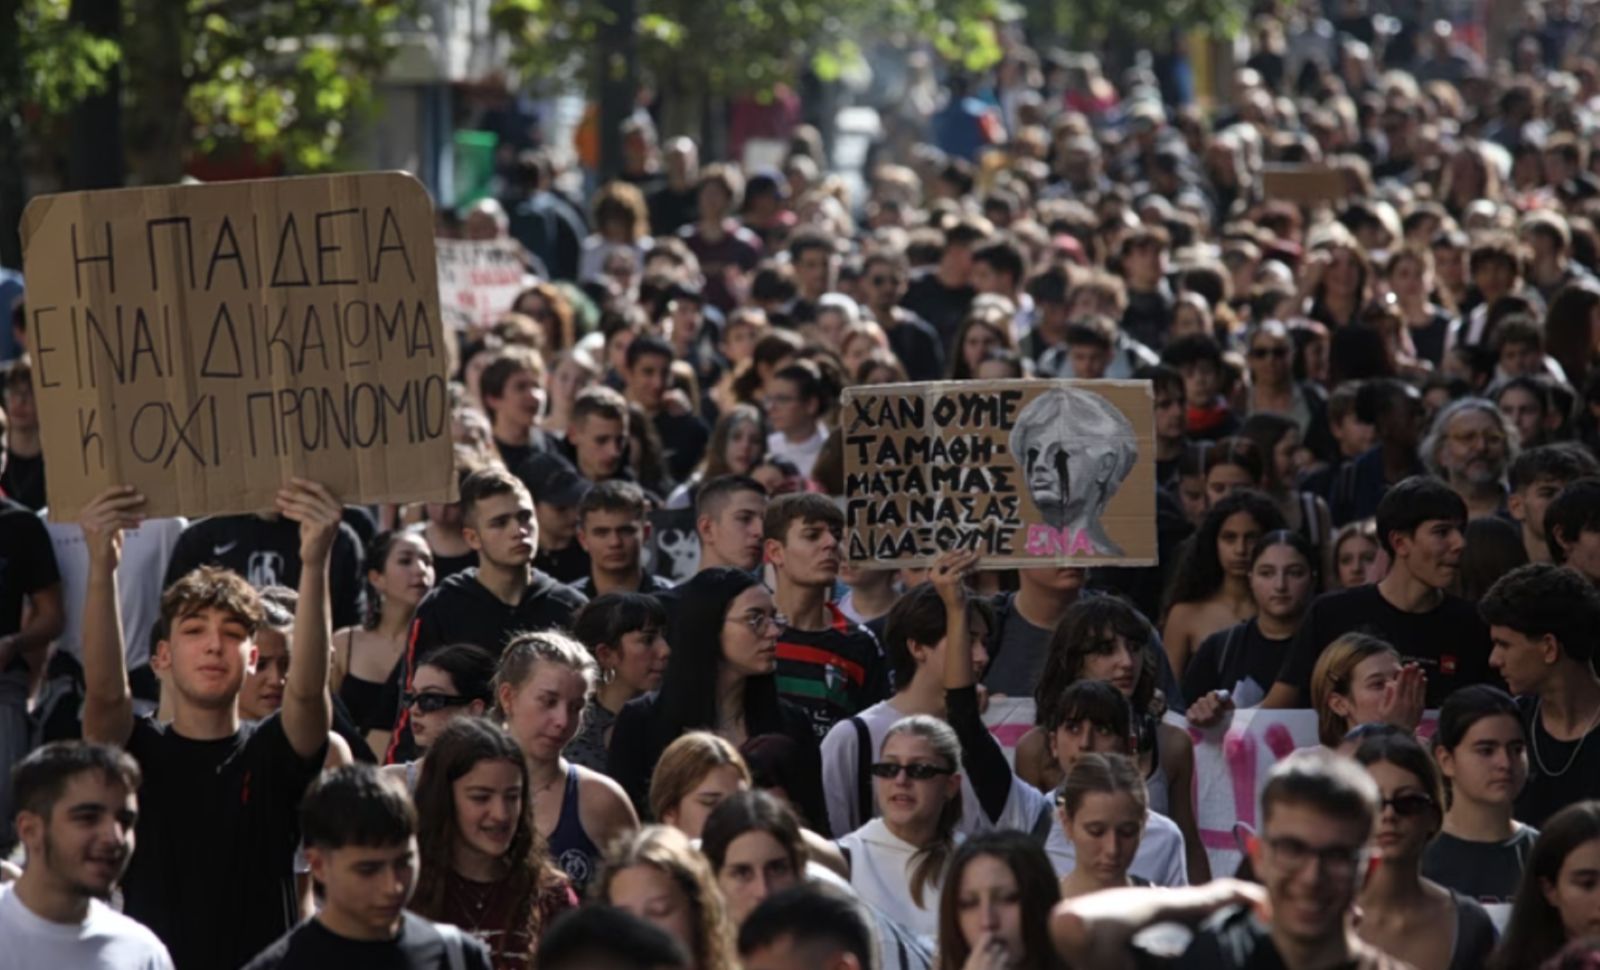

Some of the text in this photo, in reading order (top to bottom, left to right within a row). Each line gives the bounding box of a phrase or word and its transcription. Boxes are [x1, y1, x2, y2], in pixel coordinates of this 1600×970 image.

[70, 205, 417, 299] Η ΠΑΙΔΕΙΑ
[33, 303, 174, 389] ΕΙΝΑΙ
[130, 394, 220, 469] ΟΧΙ
[246, 374, 447, 457] ΠΡΟΝΟΜΙΟ
